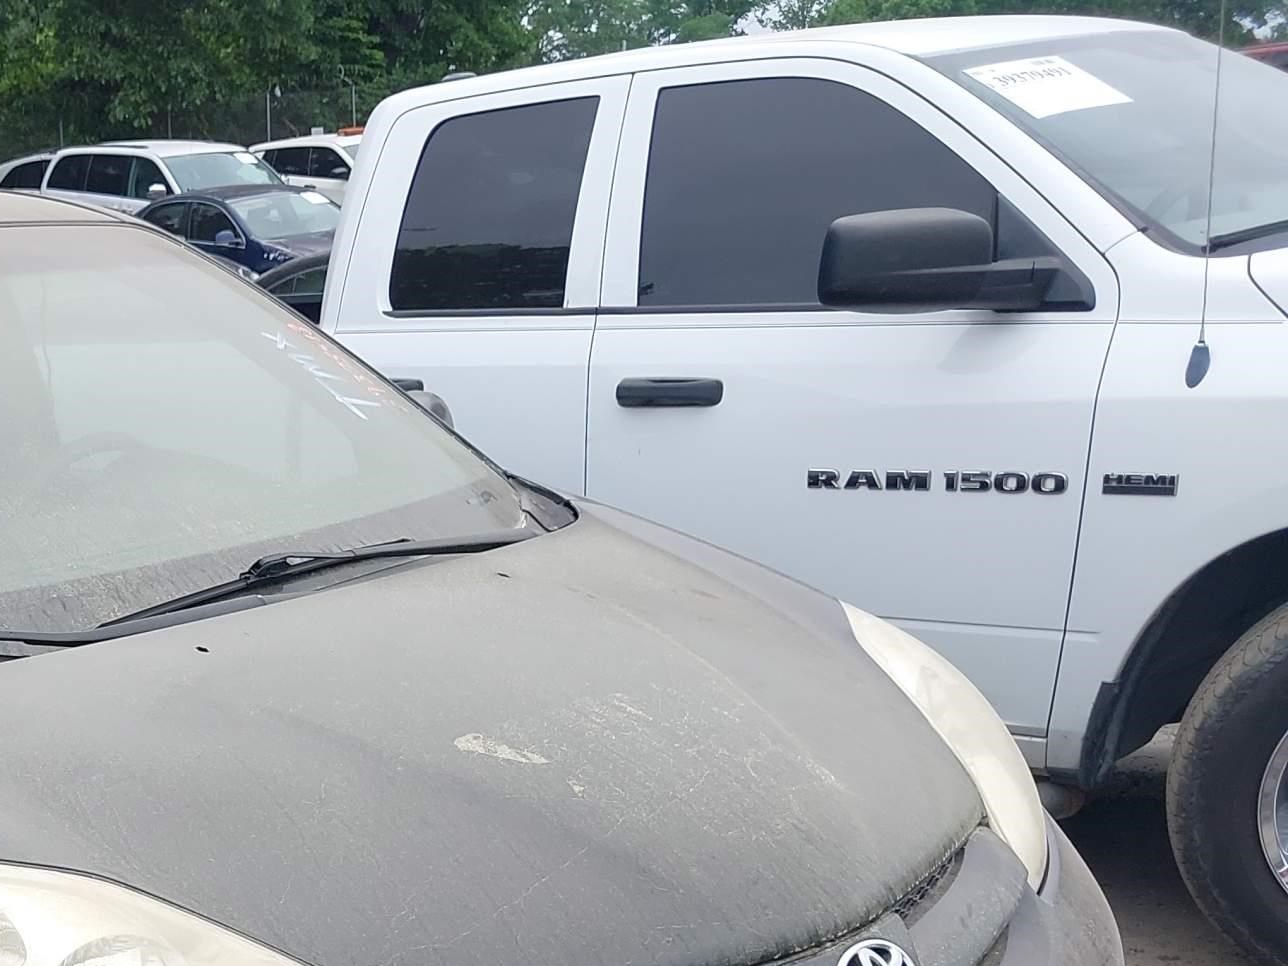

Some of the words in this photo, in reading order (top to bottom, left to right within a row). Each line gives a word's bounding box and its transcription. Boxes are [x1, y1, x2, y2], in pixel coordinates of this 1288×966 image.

[807, 468, 931, 491] RAM
[943, 470, 1068, 495] 1500
[1103, 472, 1179, 490] HEMI
